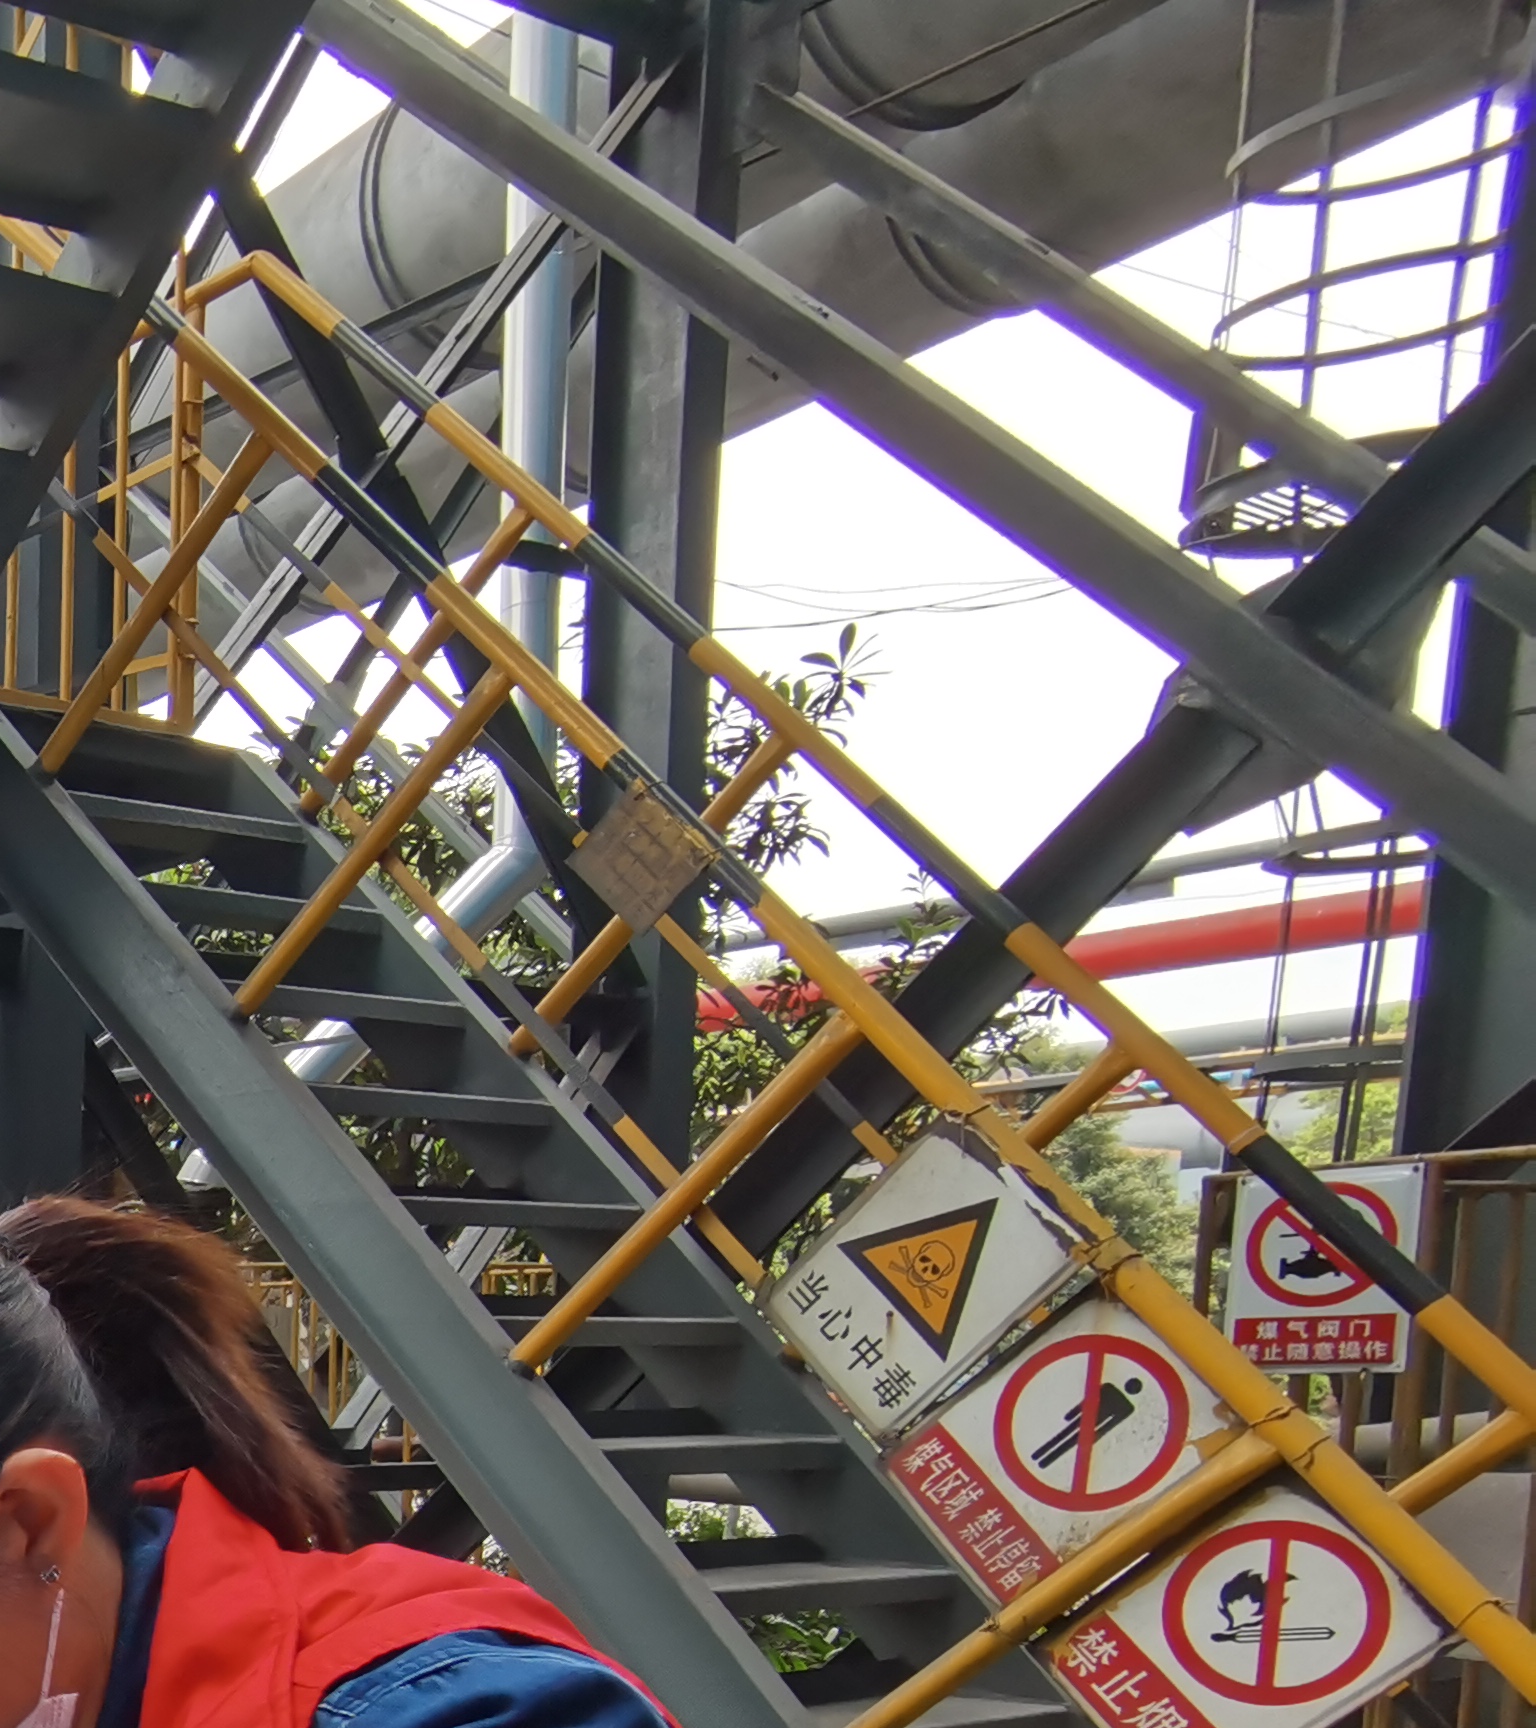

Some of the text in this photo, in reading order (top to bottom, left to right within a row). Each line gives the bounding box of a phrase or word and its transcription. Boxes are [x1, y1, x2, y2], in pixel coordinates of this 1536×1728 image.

[785, 1268, 917, 1410] 当心中毒
[1239, 1340, 1389, 1361] 禁止随意操作
[1255, 1319, 1372, 1340] 煤气阀门
[902, 1437, 1042, 1592] 煤气区域 禁止停留
